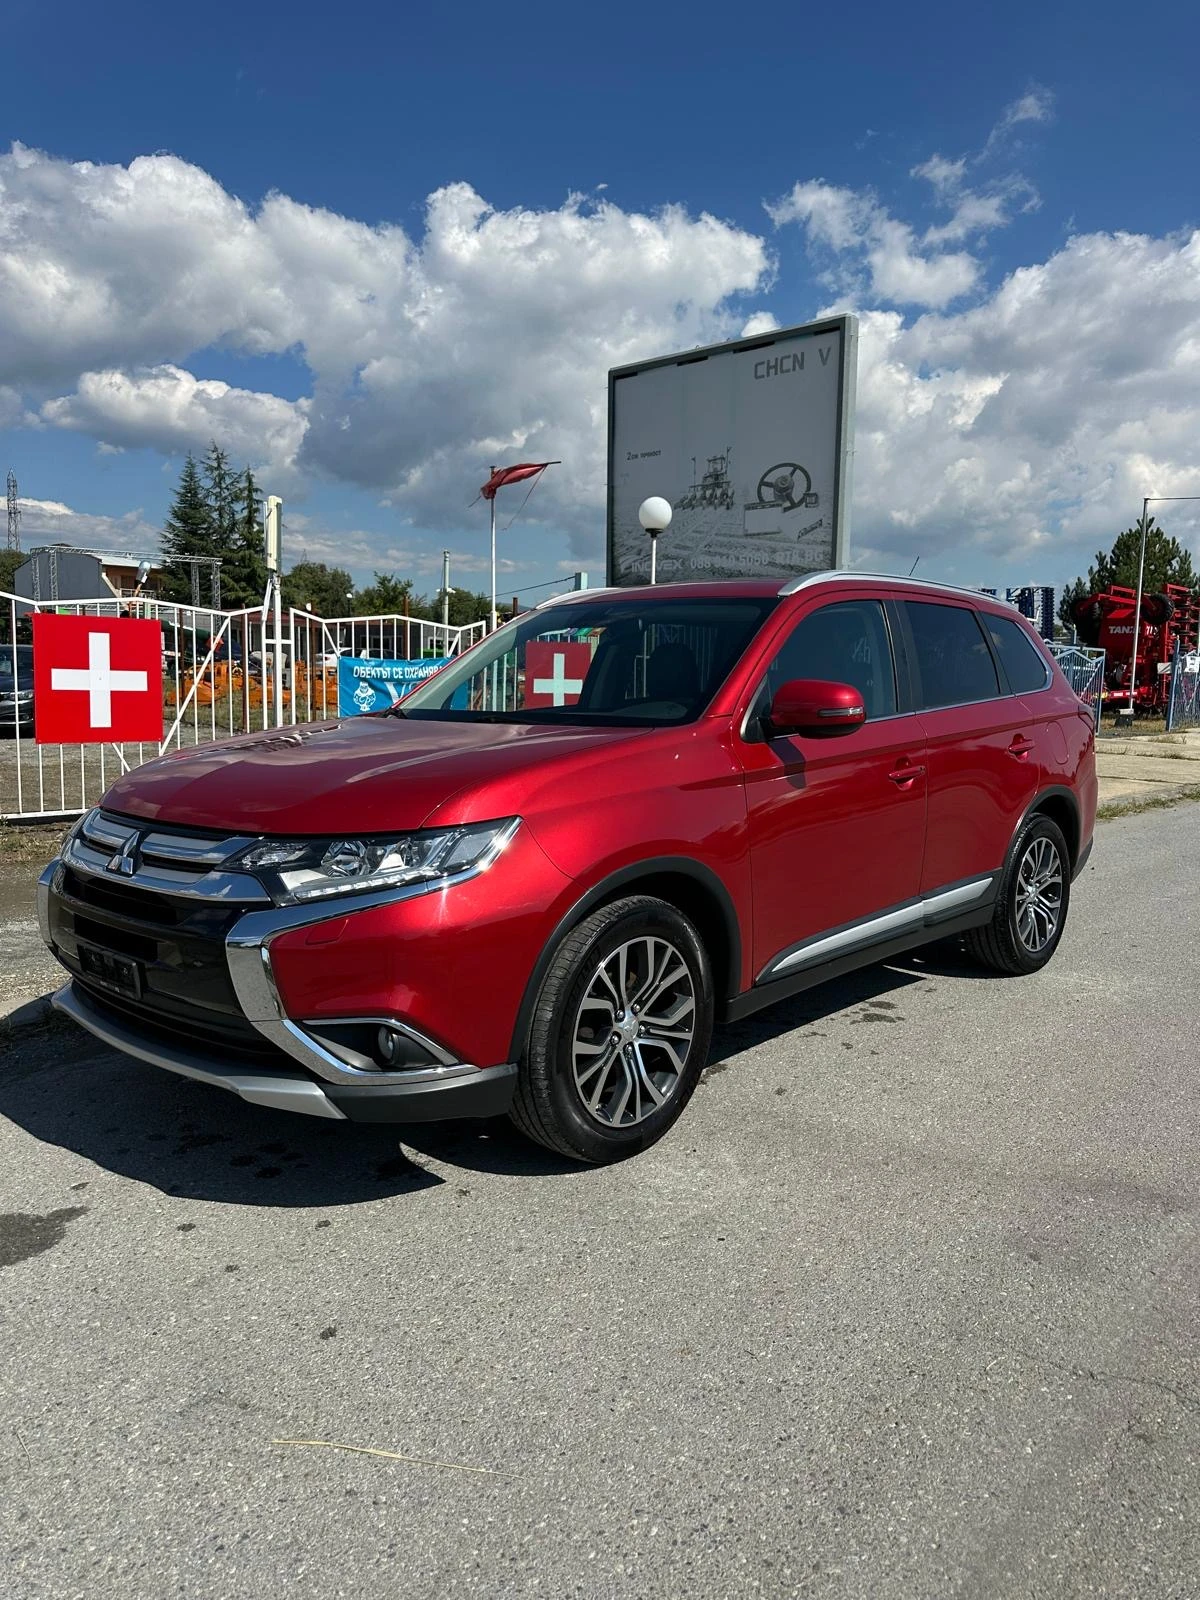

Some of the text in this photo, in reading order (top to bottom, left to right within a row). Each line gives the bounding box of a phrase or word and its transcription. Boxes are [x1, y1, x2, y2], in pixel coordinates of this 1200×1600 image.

[353, 665, 443, 679] ОБЕКТЪТ СЕ ОХРАНЯВ
